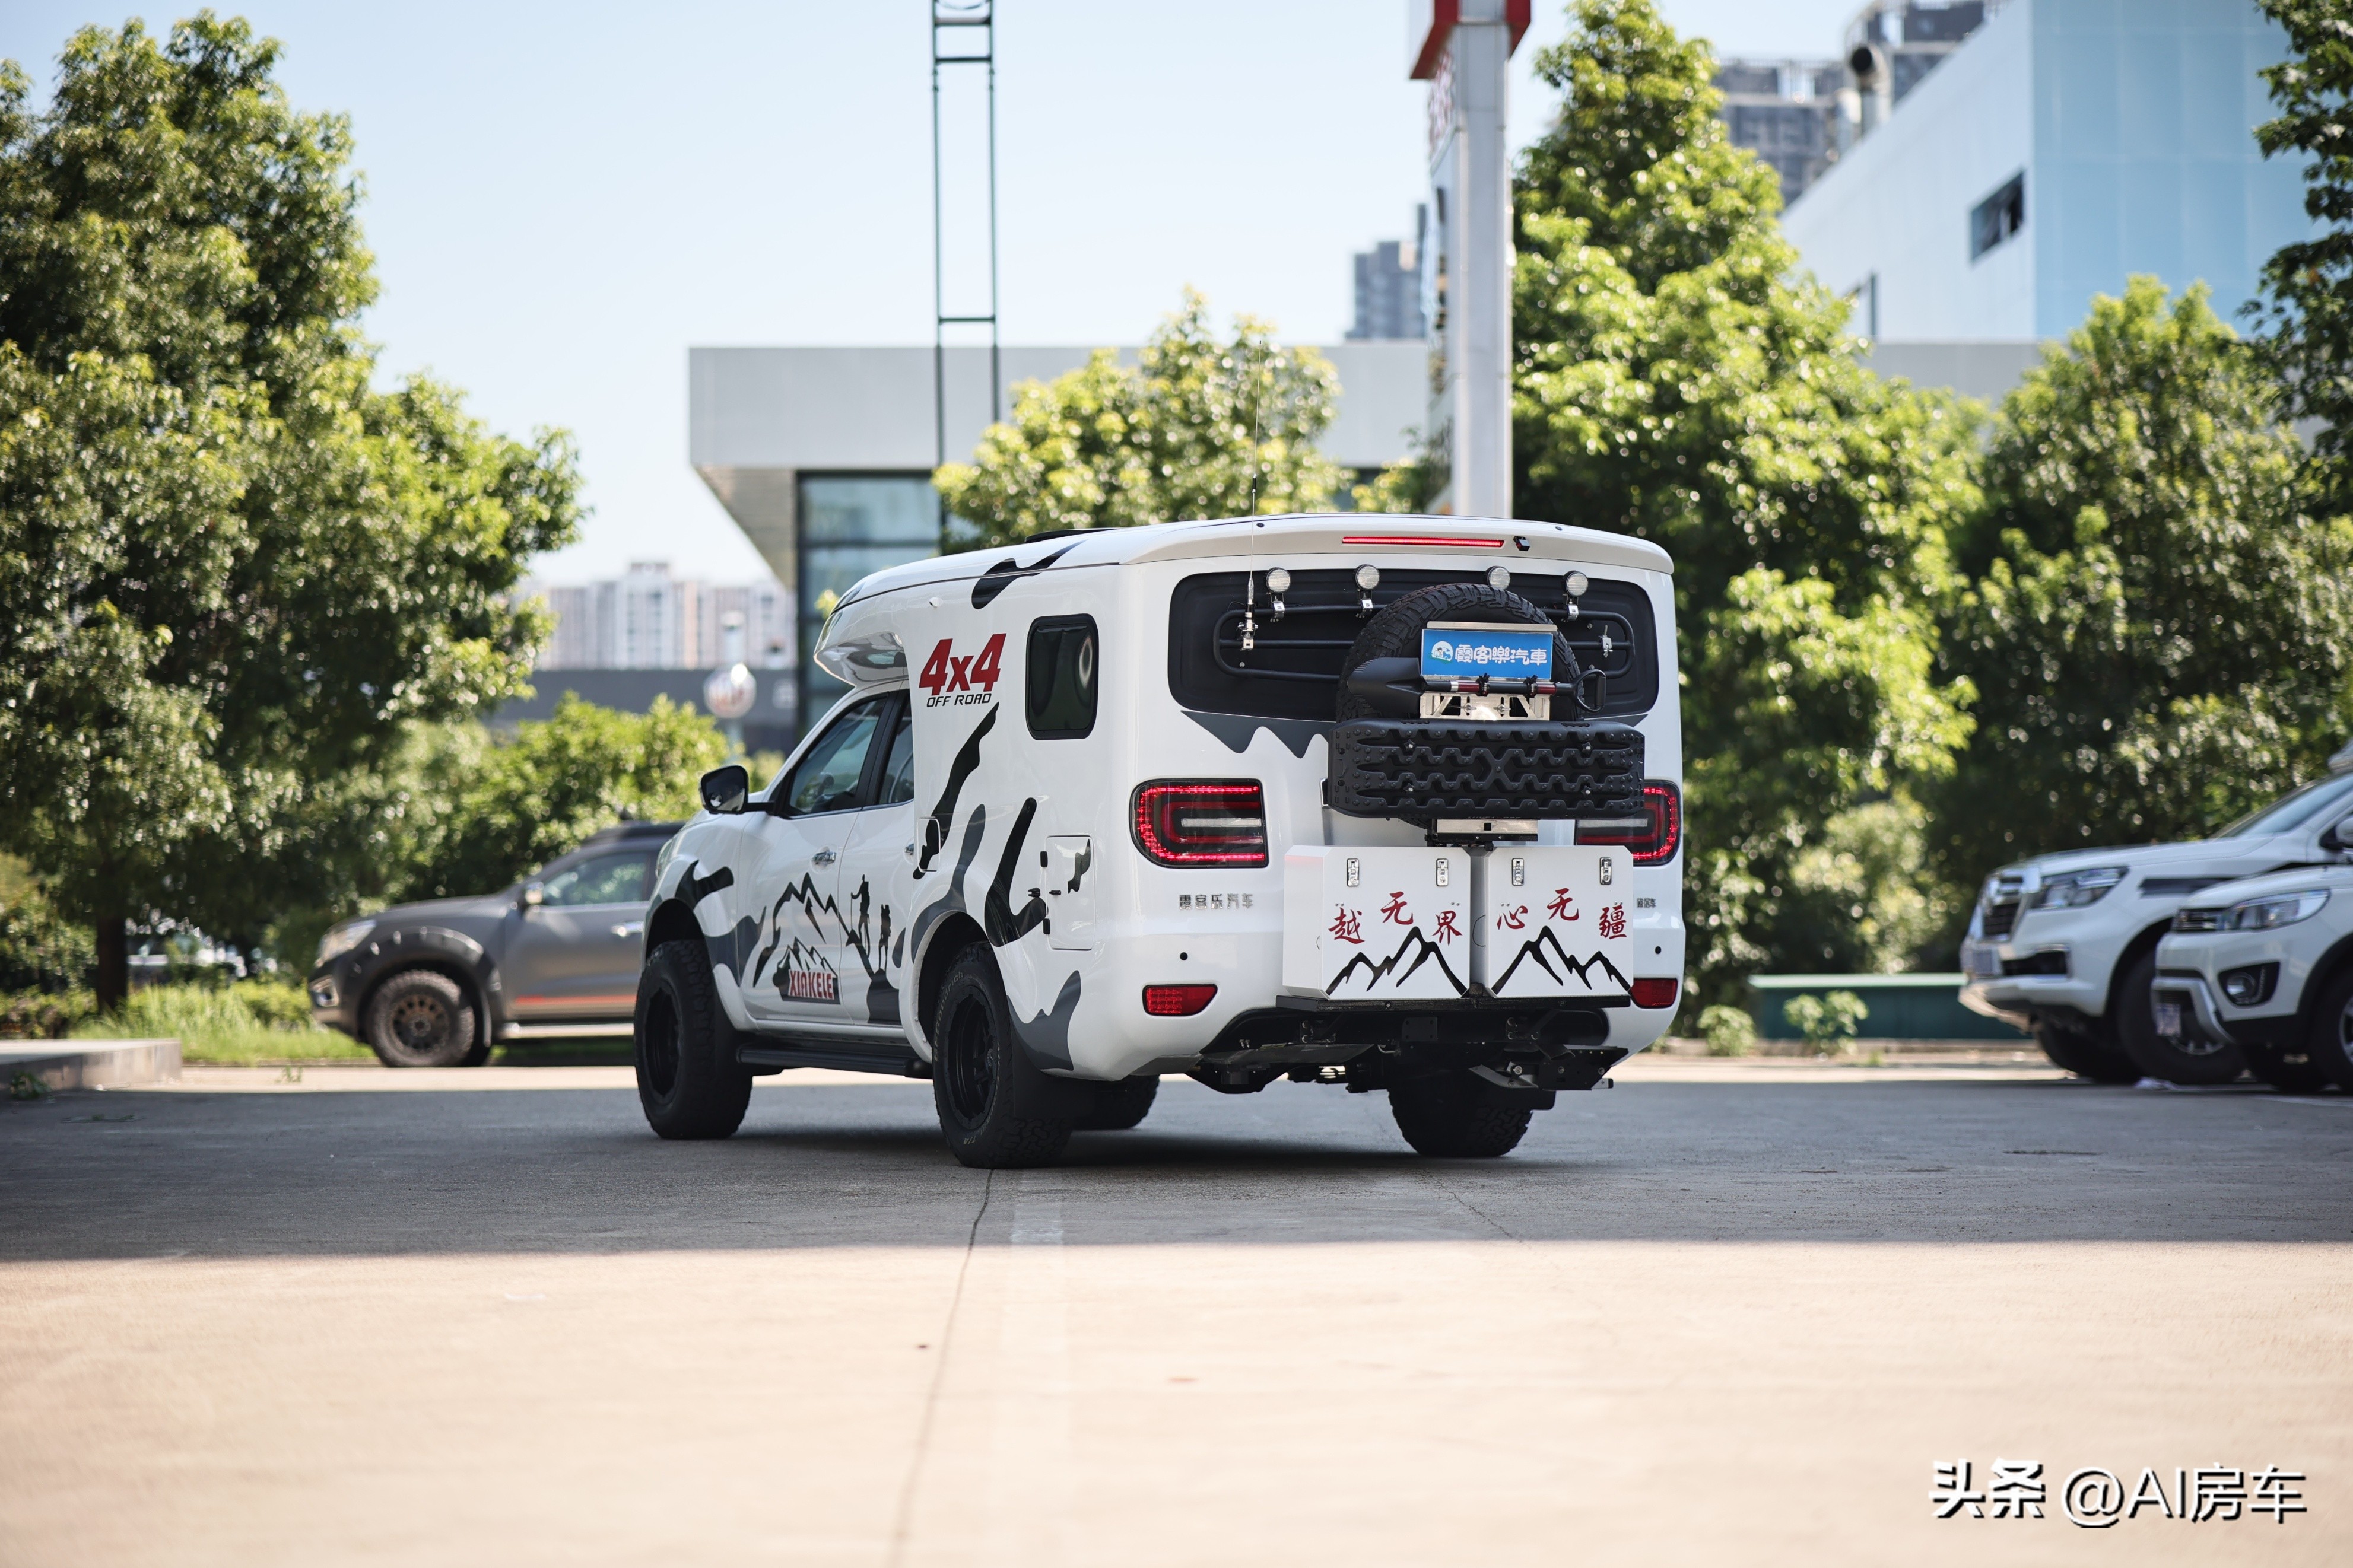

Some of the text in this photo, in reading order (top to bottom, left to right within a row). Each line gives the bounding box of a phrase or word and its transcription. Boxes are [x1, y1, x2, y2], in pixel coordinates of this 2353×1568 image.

[919, 633, 1006, 696] 4x4
[1455, 644, 1548, 666] 霞客樂汽車
[926, 693, 992, 708] OFF ROAD
[1179, 893, 1253, 909] 霞客乐汽车
[788, 969, 834, 1000] XIAKELE
